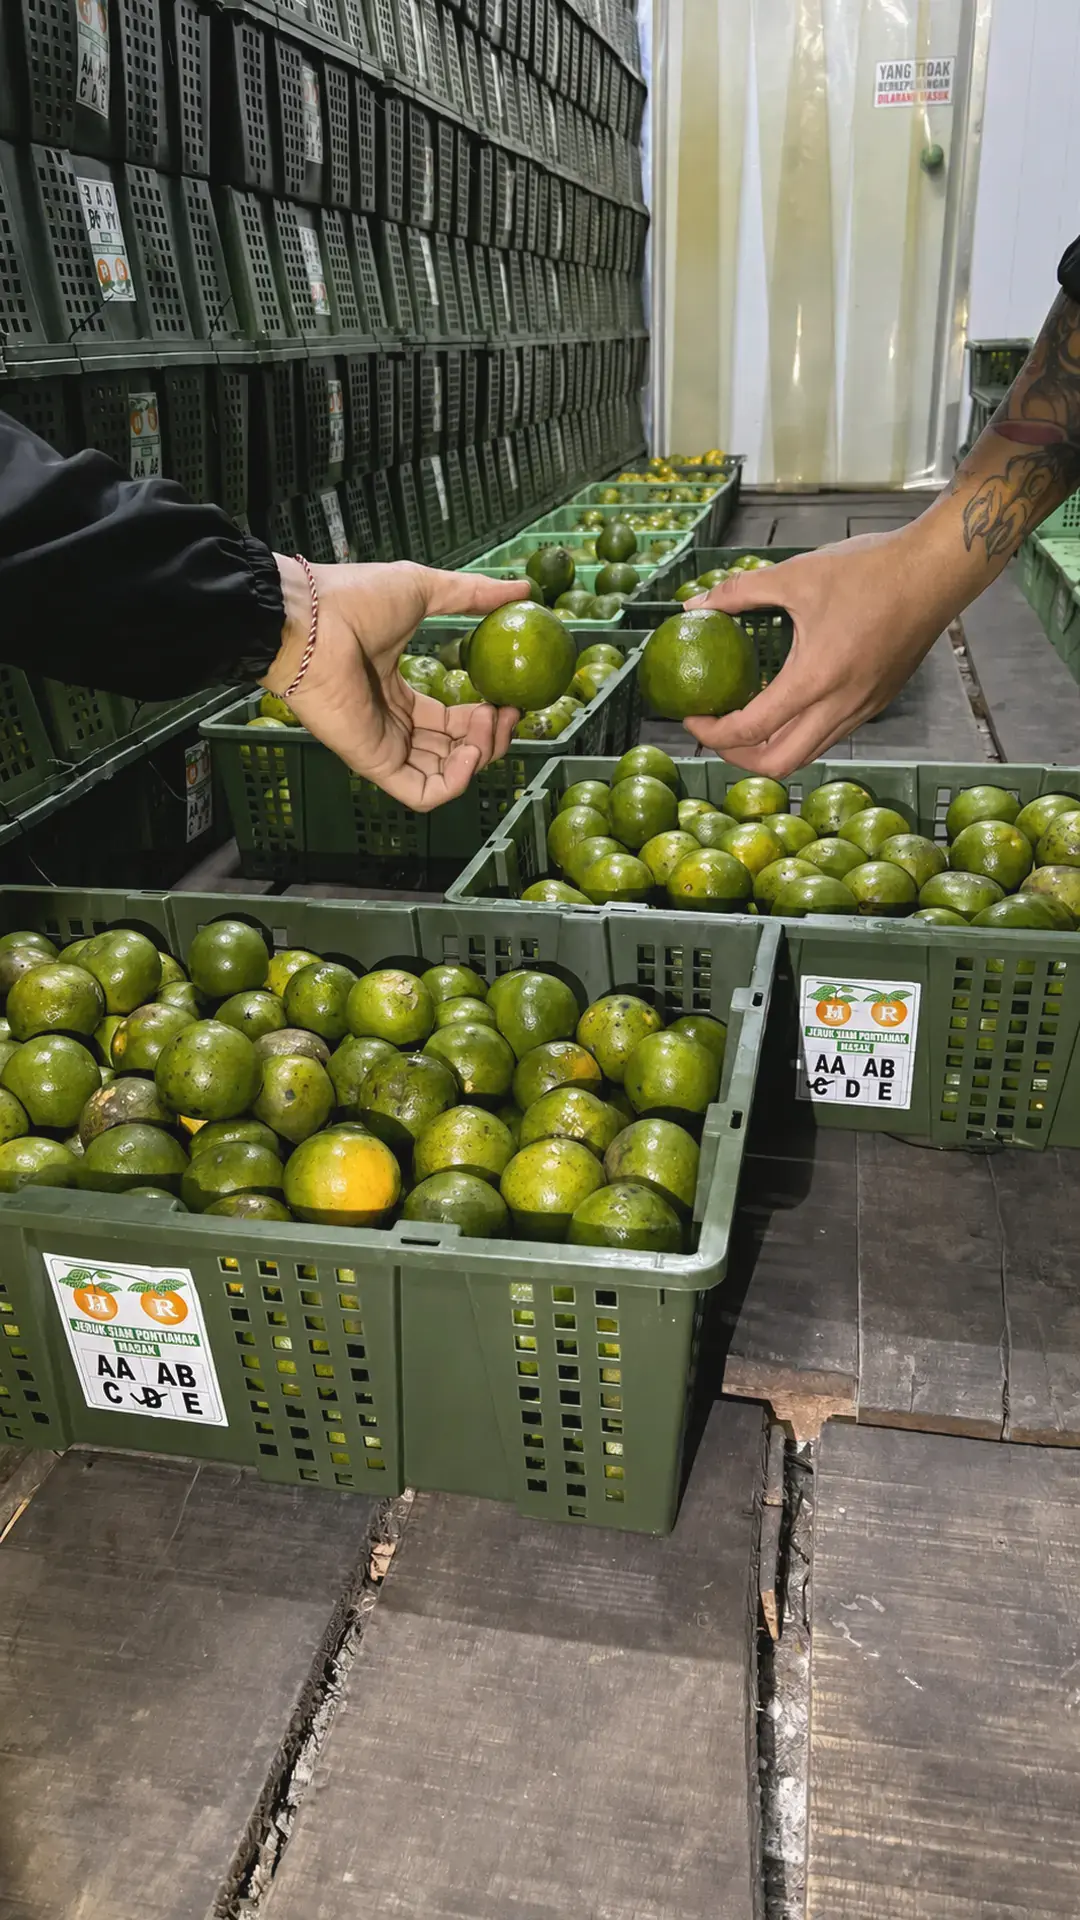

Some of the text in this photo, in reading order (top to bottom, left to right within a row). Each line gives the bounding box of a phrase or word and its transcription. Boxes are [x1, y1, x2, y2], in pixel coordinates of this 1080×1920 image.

[880, 63, 911, 80] YANG
[880, 1006, 898, 1022] R
[814, 1054, 895, 1079] AA AB
[845, 1079, 861, 1098] D
[878, 1082, 892, 1101] E
[153, 1298, 179, 1318] R
[74, 1320, 198, 1346] JERUK SIAM PONTIANAK
[117, 1341, 157, 1356] MASAK
[97, 1354, 197, 1388] AA AB
[103, 1381, 204, 1415] C D E
